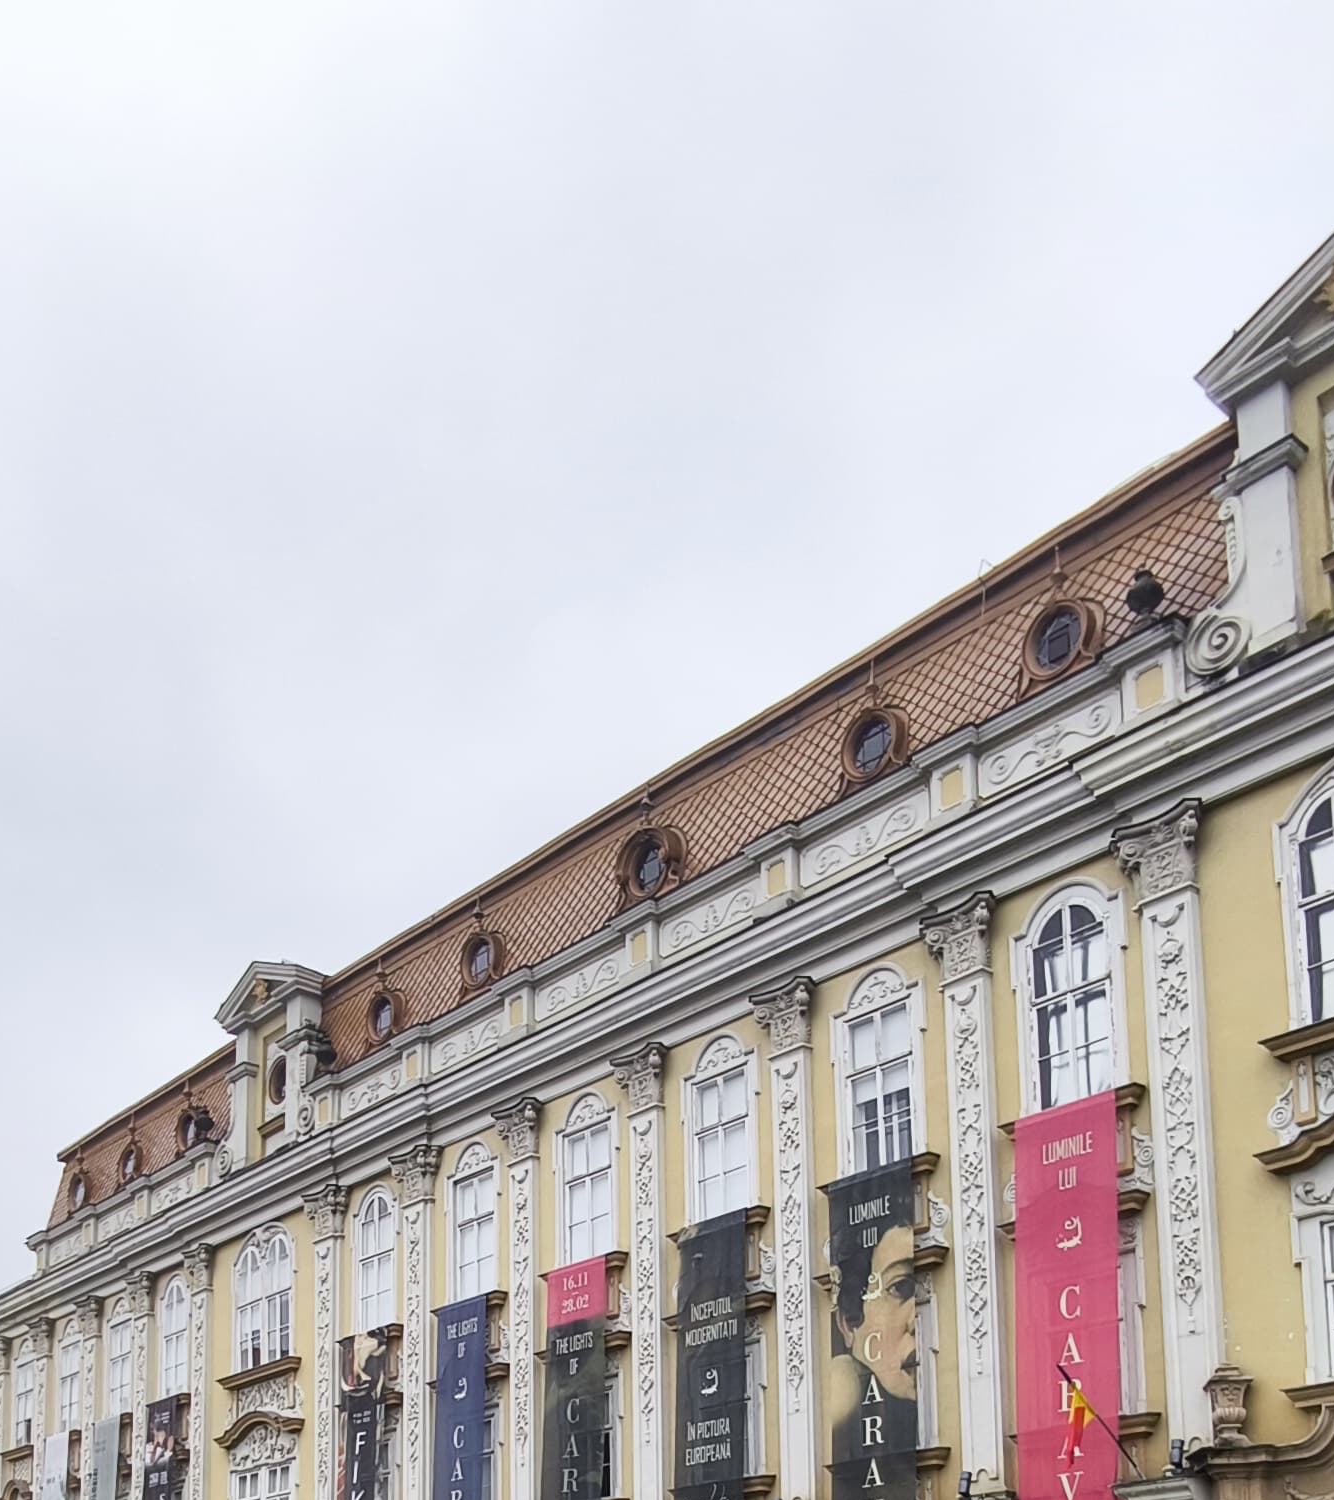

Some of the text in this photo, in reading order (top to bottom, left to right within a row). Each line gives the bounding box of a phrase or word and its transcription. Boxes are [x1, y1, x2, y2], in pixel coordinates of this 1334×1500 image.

[1042, 1131, 1094, 1165] LUMINILE
[1058, 1166, 1078, 1191] LUI
[849, 1195, 891, 1225] LUMINILE
[863, 1227, 878, 1248] LUI
[562, 1272, 588, 1291] 16.11
[561, 1294, 589, 1314] 28.02
[690, 1296, 733, 1323] ÎNCEPUTUL
[447, 1317, 478, 1340] THE LIGHTS
[556, 1331, 594, 1355] THE LIGHTS
[569, 1358, 579, 1375] OF
[697, 1416, 731, 1440] PICTURA
[685, 1439, 732, 1466] EUROPEANĂ
